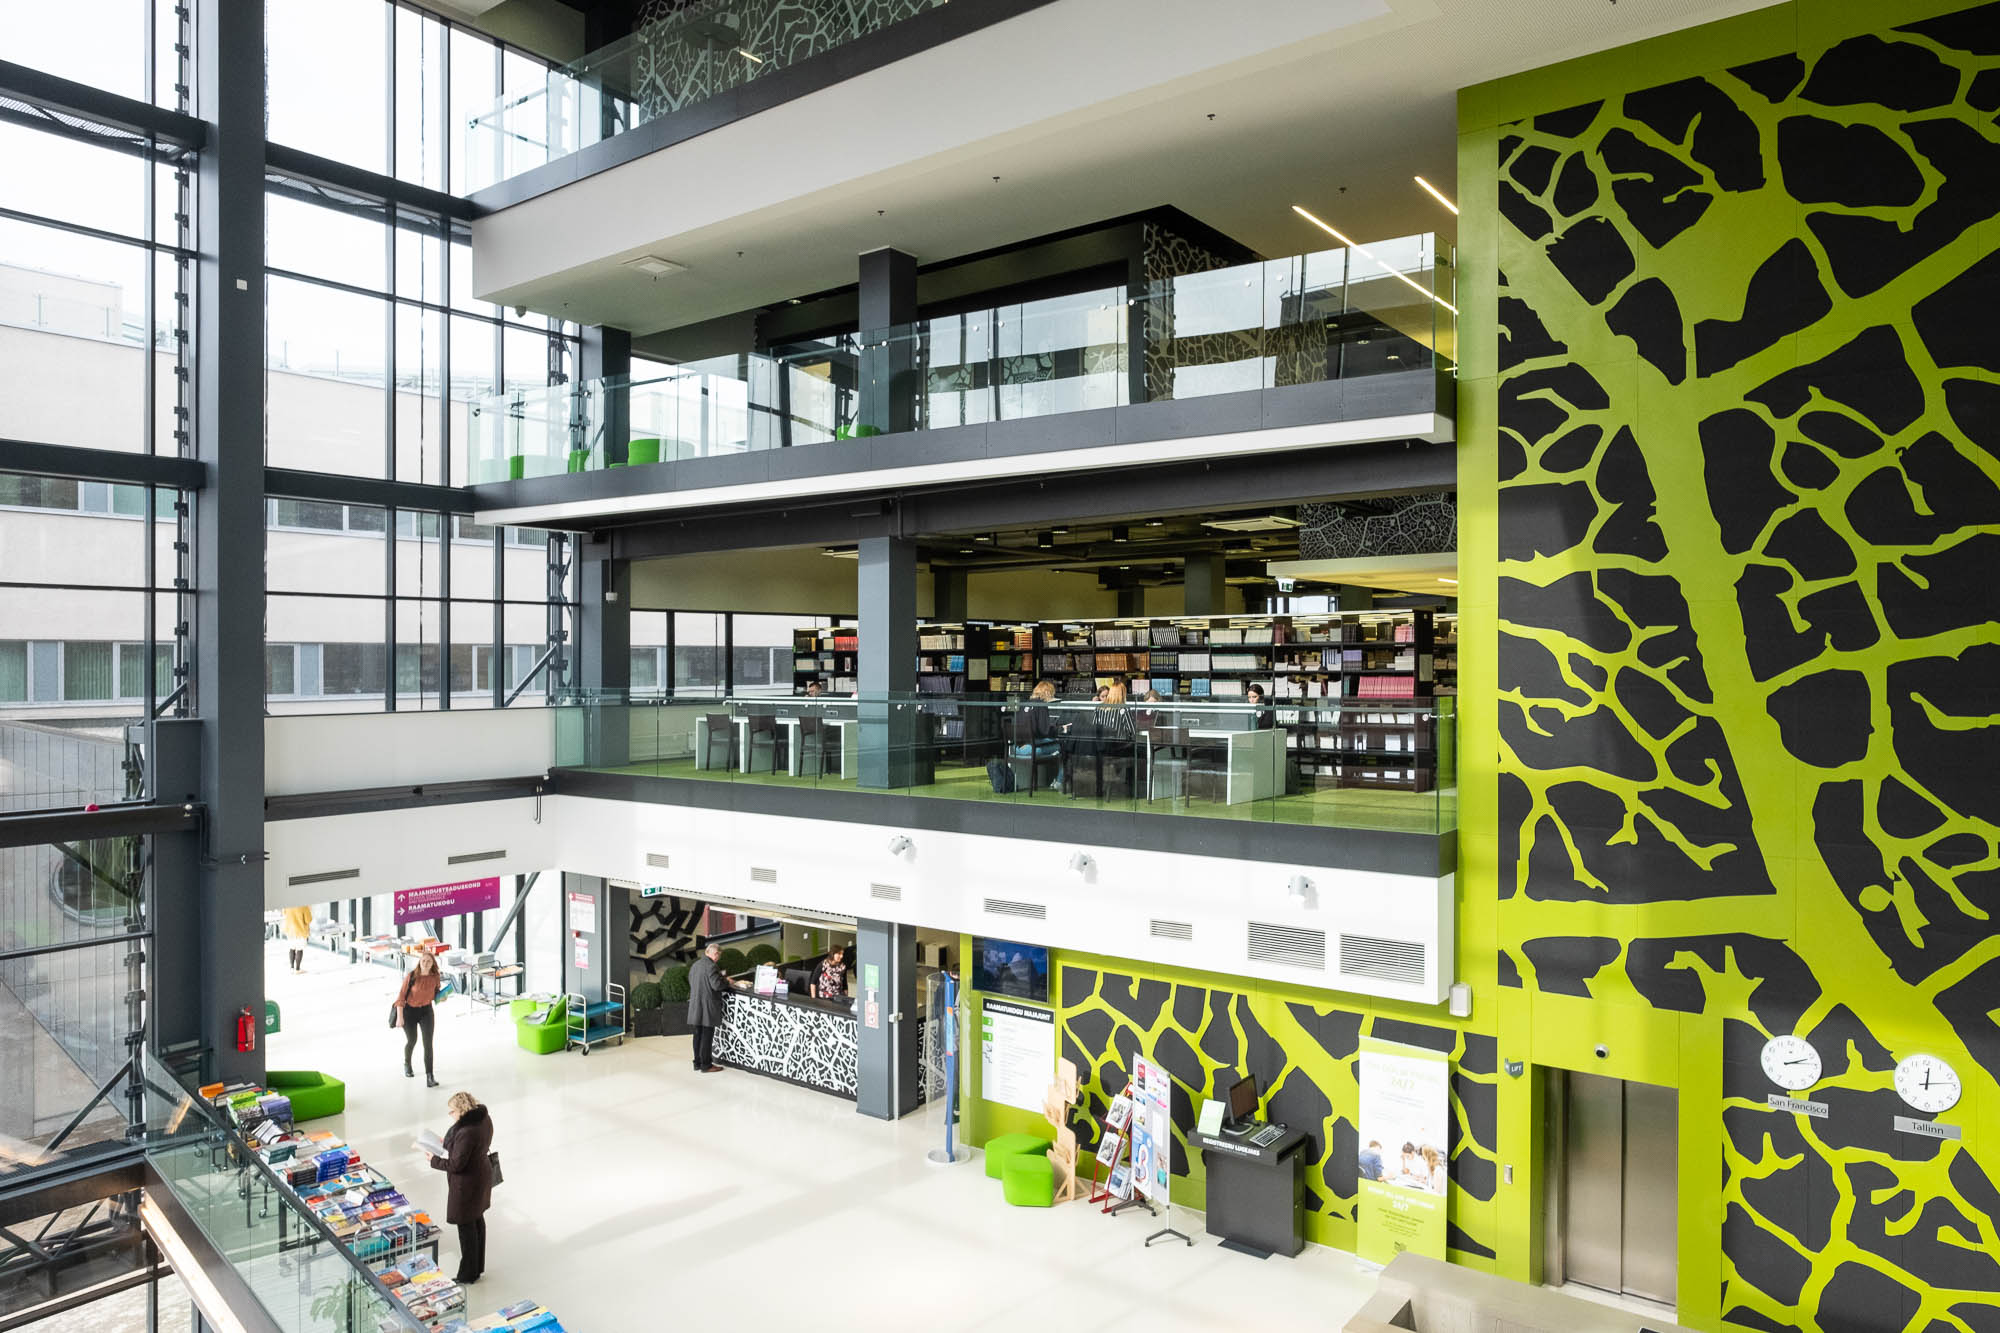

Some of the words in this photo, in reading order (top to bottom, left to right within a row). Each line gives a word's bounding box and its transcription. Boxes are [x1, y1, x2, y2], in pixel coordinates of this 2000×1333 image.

[408, 899, 455, 911] RAAMATUKOGU
[1511, 1064, 1522, 1072] LIFT
[1770, 1096, 1785, 1107] San
[1787, 1100, 1827, 1114] Francisco
[1911, 1121, 1944, 1135] Tallinn
